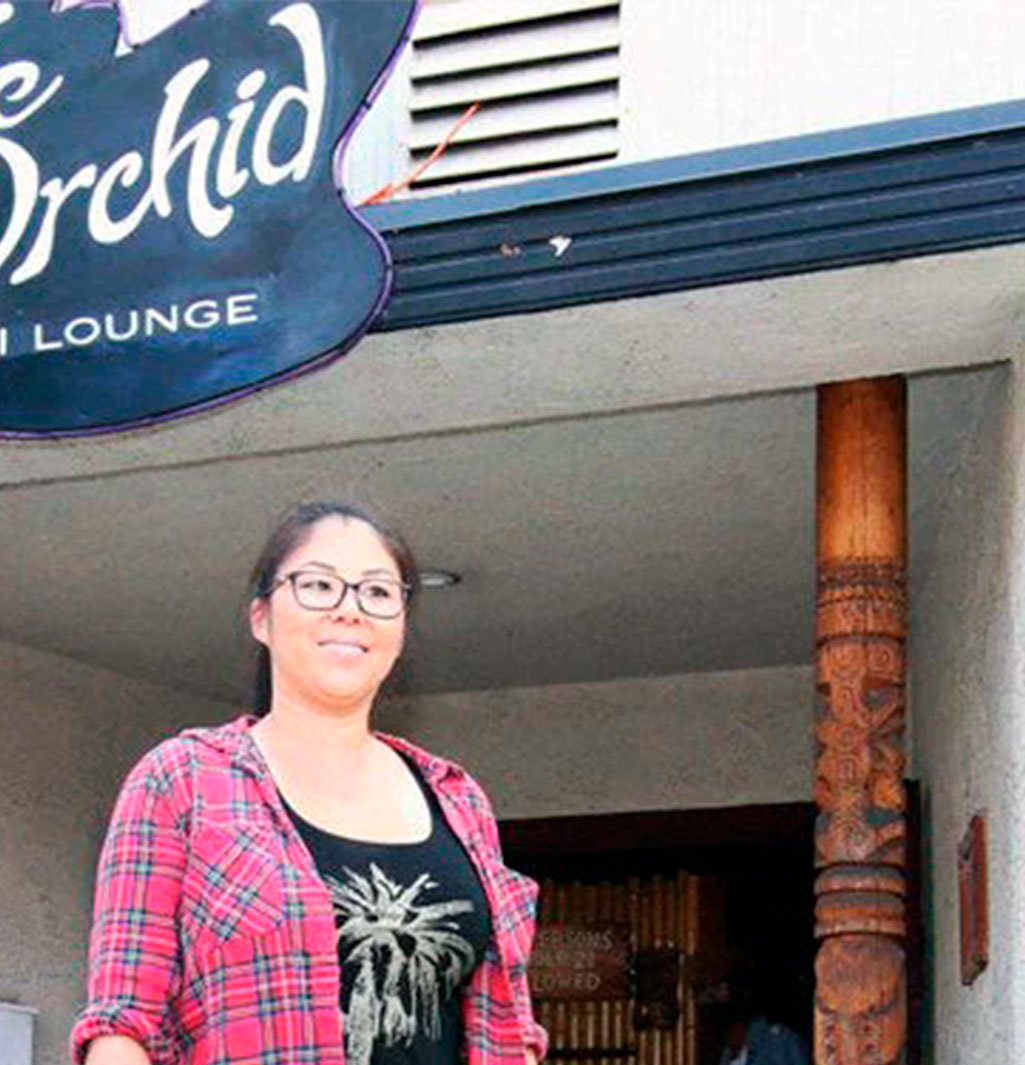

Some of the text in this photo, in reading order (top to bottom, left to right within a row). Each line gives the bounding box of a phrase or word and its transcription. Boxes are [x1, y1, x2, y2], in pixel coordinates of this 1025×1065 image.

[34, 293, 259, 350] LOUNGE
[538, 928, 614, 951] ERSONS
[532, 971, 602, 992] LOWED
